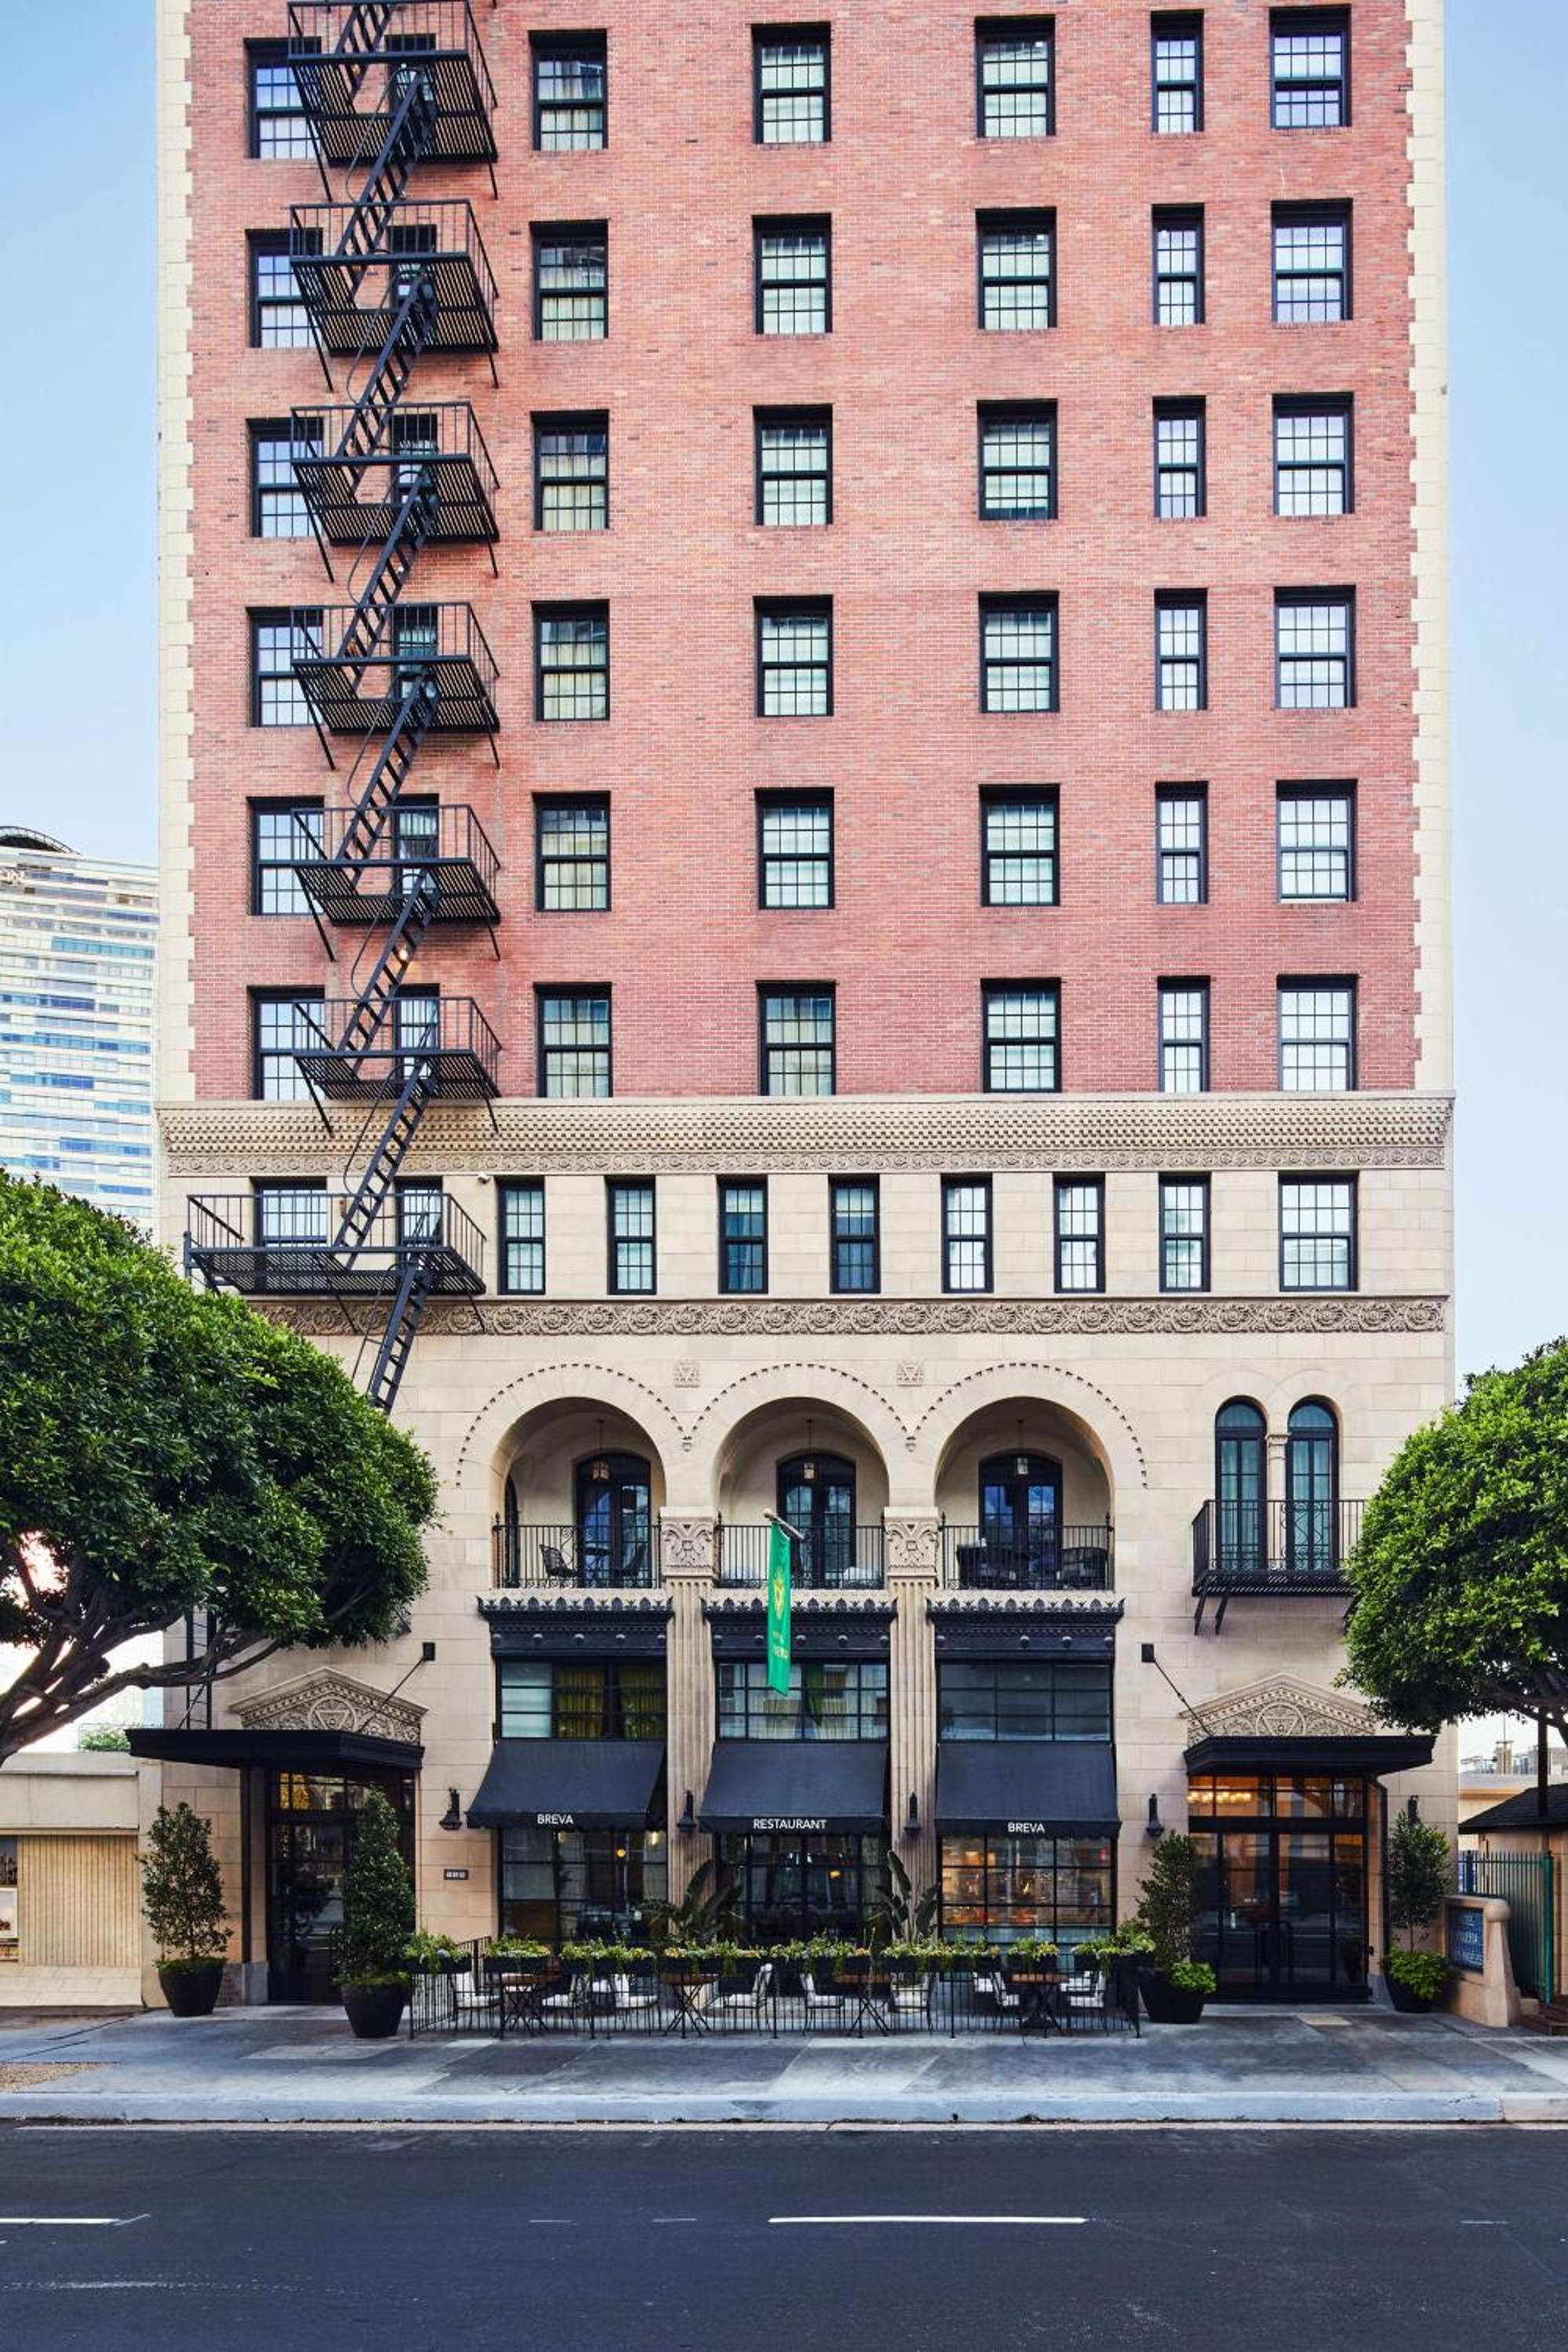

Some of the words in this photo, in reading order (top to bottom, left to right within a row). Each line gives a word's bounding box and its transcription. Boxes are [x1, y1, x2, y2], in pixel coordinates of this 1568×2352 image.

[537, 1813, 574, 1824] BREVA
[753, 1818, 827, 1829] RESTAURANT
[1007, 1821, 1045, 1833] BREVA
